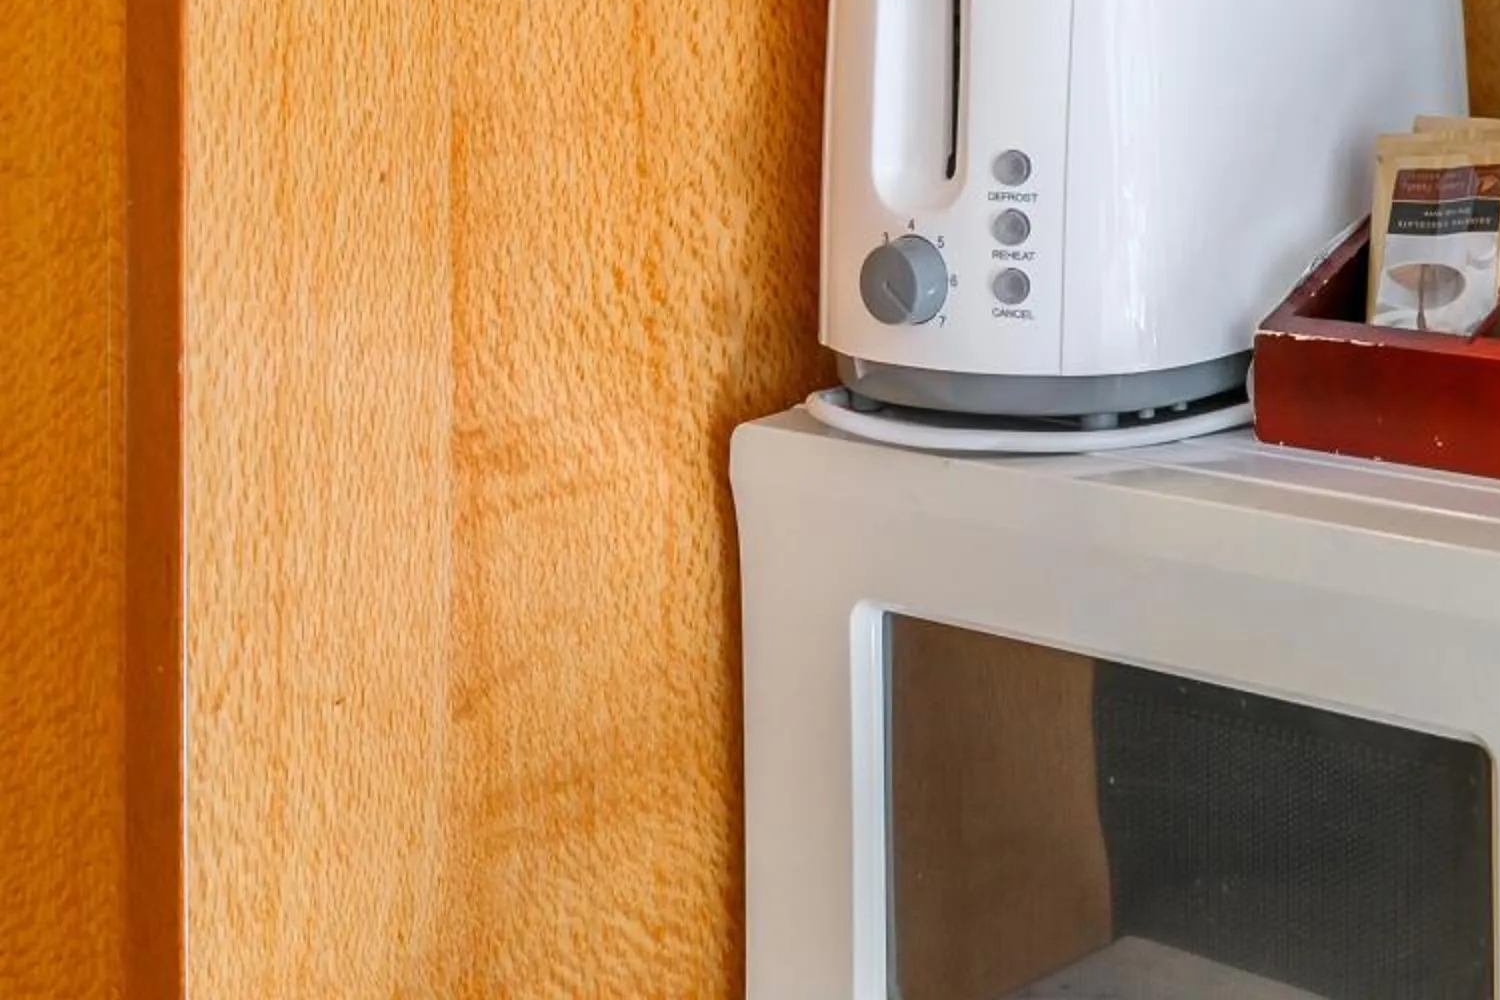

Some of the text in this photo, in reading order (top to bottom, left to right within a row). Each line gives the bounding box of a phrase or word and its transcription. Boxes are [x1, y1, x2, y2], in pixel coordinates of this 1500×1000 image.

[987, 191, 1039, 202] DEFROST
[907, 218, 915, 231] 4
[937, 235, 945, 249] 5
[991, 249, 1036, 260] REHEAT
[949, 274, 958, 287] 6
[991, 308, 1035, 320] CANCEL
